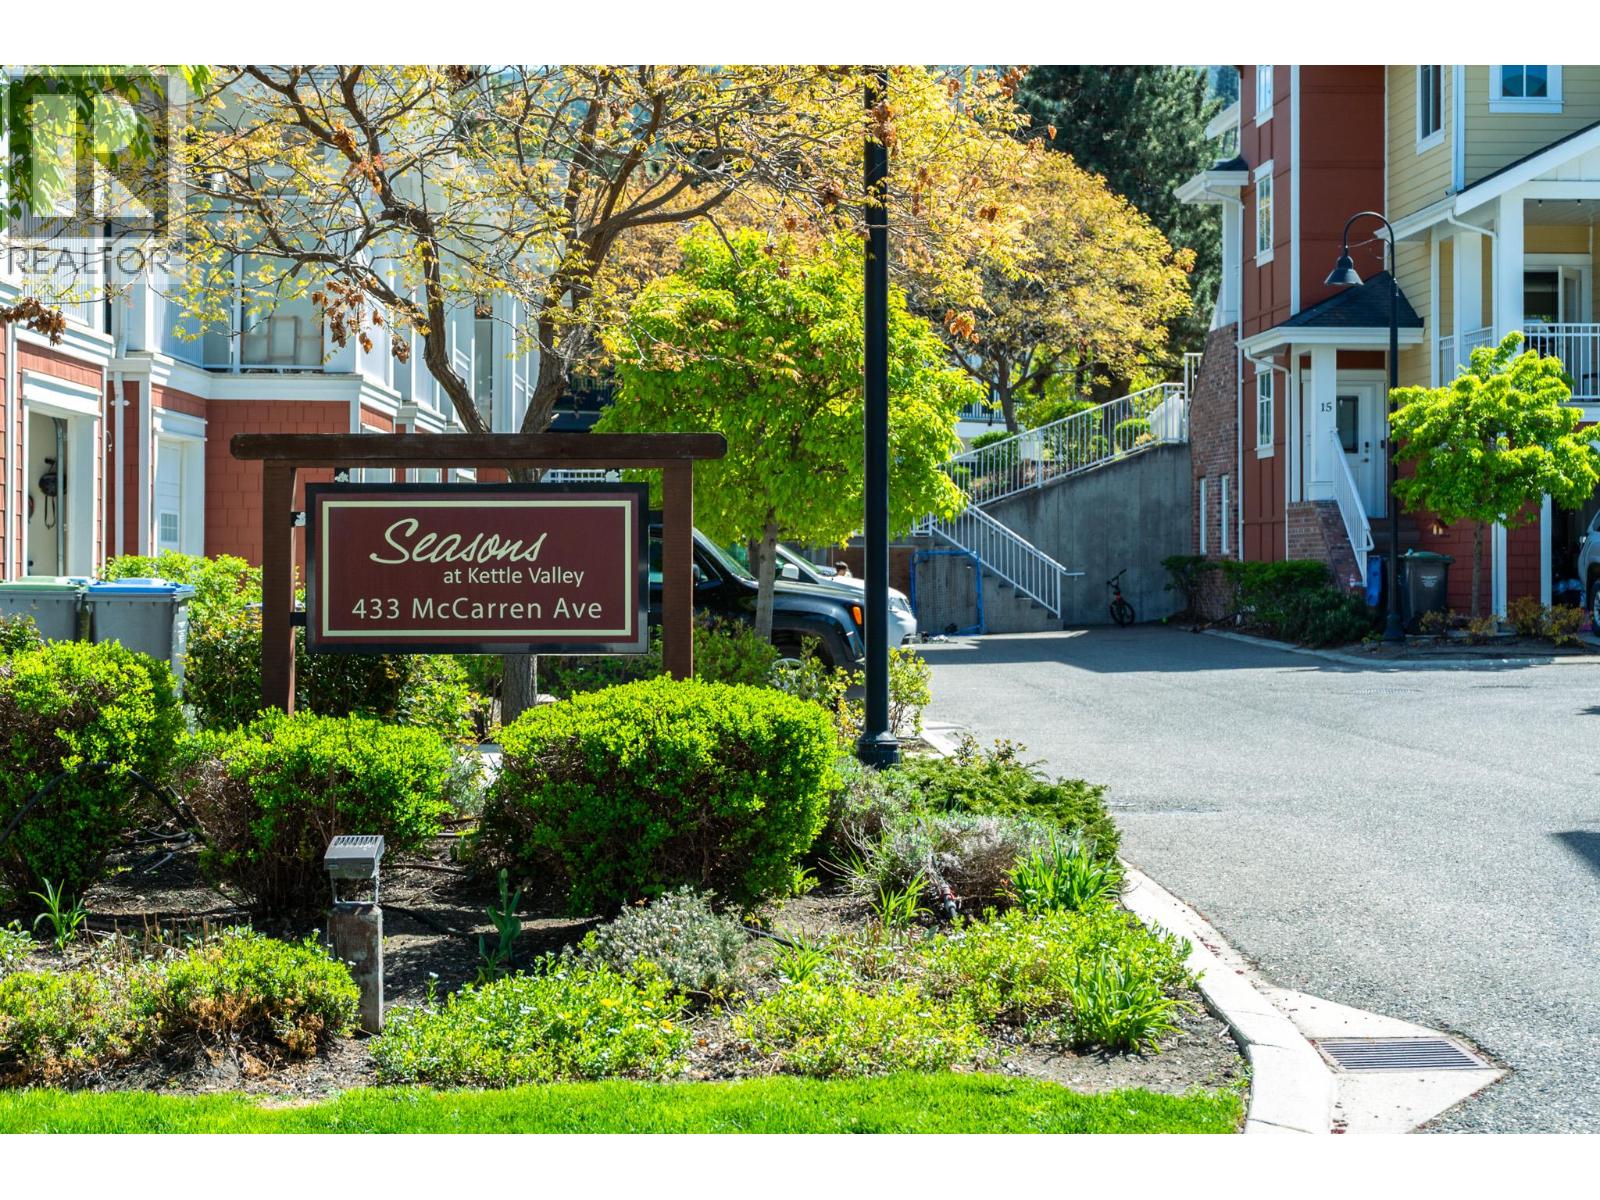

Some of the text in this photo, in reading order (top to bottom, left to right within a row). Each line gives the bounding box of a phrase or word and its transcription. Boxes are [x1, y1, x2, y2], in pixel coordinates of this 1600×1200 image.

[1321, 402, 1332, 412] 15
[369, 517, 548, 565] Seasons
[443, 567, 585, 588] at Kettle Valley
[351, 597, 602, 620] 433 McCarren Ave
